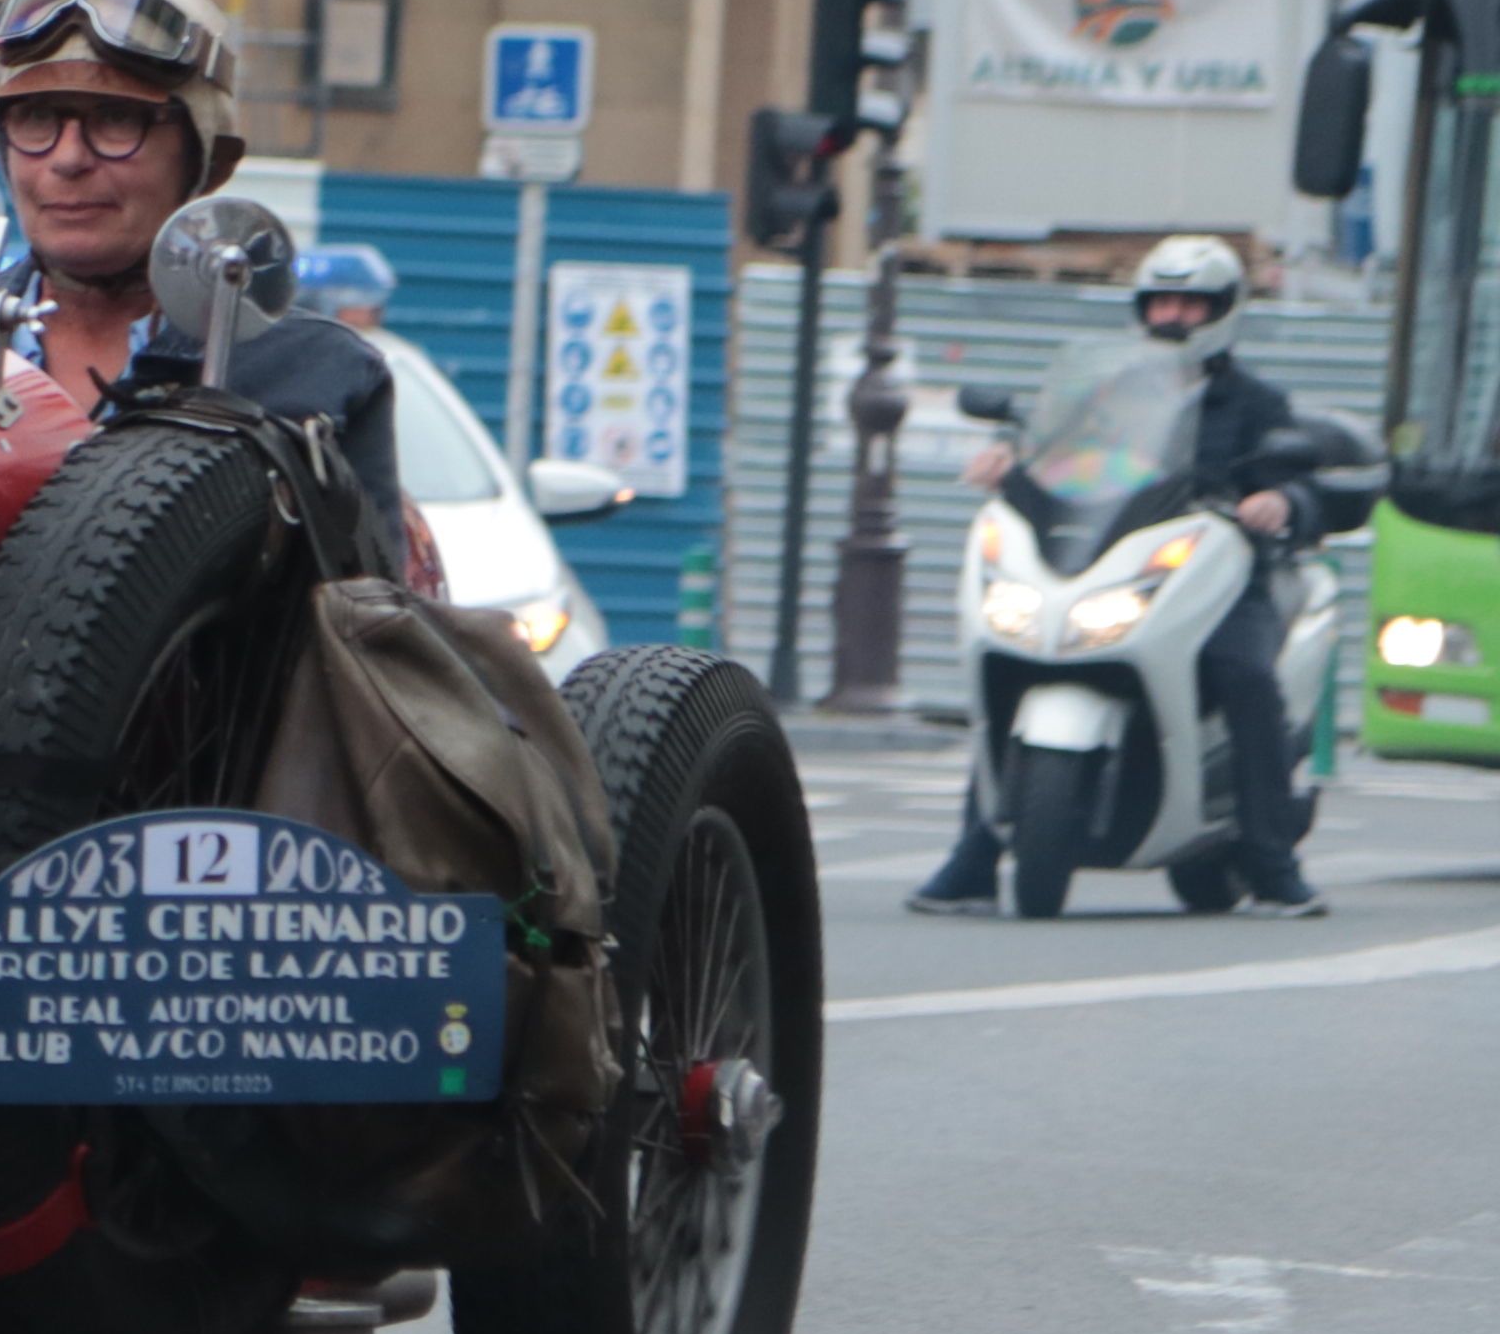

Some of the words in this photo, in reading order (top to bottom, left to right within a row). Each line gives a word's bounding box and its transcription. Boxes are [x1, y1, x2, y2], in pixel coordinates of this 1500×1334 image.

[11, 834, 136, 898] 1923
[175, 832, 230, 884] 12
[265, 829, 387, 895] 2023
[148, 903, 466, 944] CENTENARIO
[179, 951, 235, 981] DE
[250, 948, 450, 980] LASARTE
[27, 994, 126, 1024] REAL
[148, 995, 355, 1024] AUTOMOVIL
[99, 1028, 226, 1061] VASCO
[242, 1029, 420, 1063] NAVARRO
